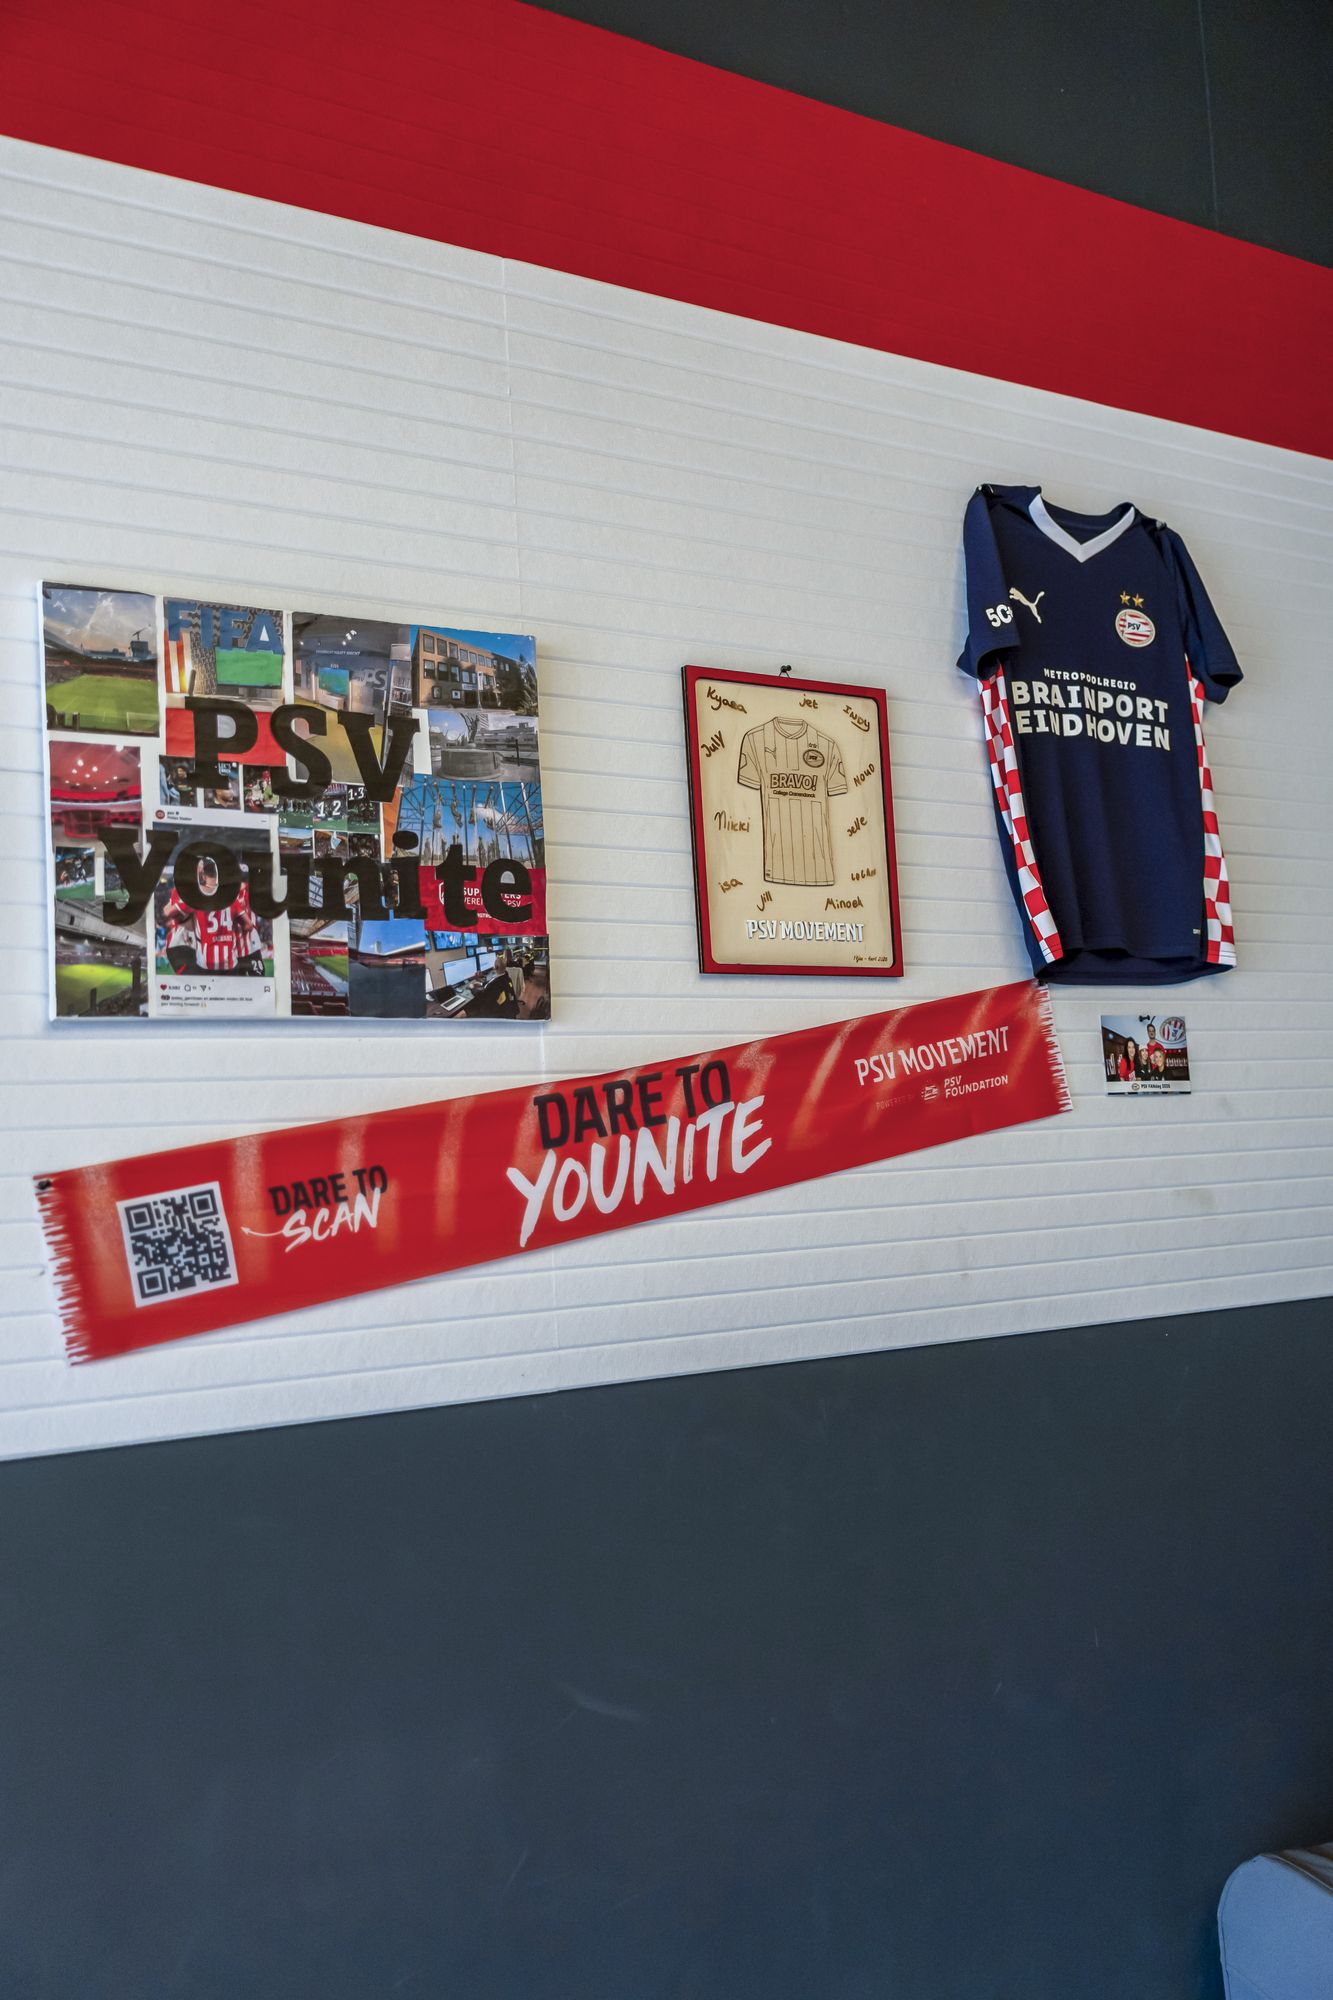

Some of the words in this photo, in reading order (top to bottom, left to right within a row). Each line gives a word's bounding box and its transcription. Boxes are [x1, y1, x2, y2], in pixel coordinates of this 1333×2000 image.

[166, 601, 285, 655] FIFA
[1127, 622, 1141, 631] PSV
[1043, 668, 1137, 691] METROPOOLREGIO
[1011, 680, 1168, 723] BRAINPORT
[185, 696, 420, 803] PSV
[1015, 709, 1170, 751] EINDHOVEN
[770, 773, 818, 791] BRAVO!
[714, 810, 750, 833] Nikki
[98, 828, 534, 927] younite
[746, 919, 777, 940] PSV
[780, 921, 864, 942] MOVEMENT
[854, 1052, 897, 1086] PSV
[899, 1026, 1009, 1076] MOVEMENT
[944, 1075, 962, 1088] PSV
[945, 1075, 1009, 1099] FOUNDATION
[534, 1072, 667, 1150] DARE
[675, 1060, 731, 1118] TO
[268, 1173, 349, 1216] DARE
[352, 1165, 388, 1197] TO
[506, 1095, 772, 1248] YOUNITE
[281, 1187, 381, 1253] SCAN
